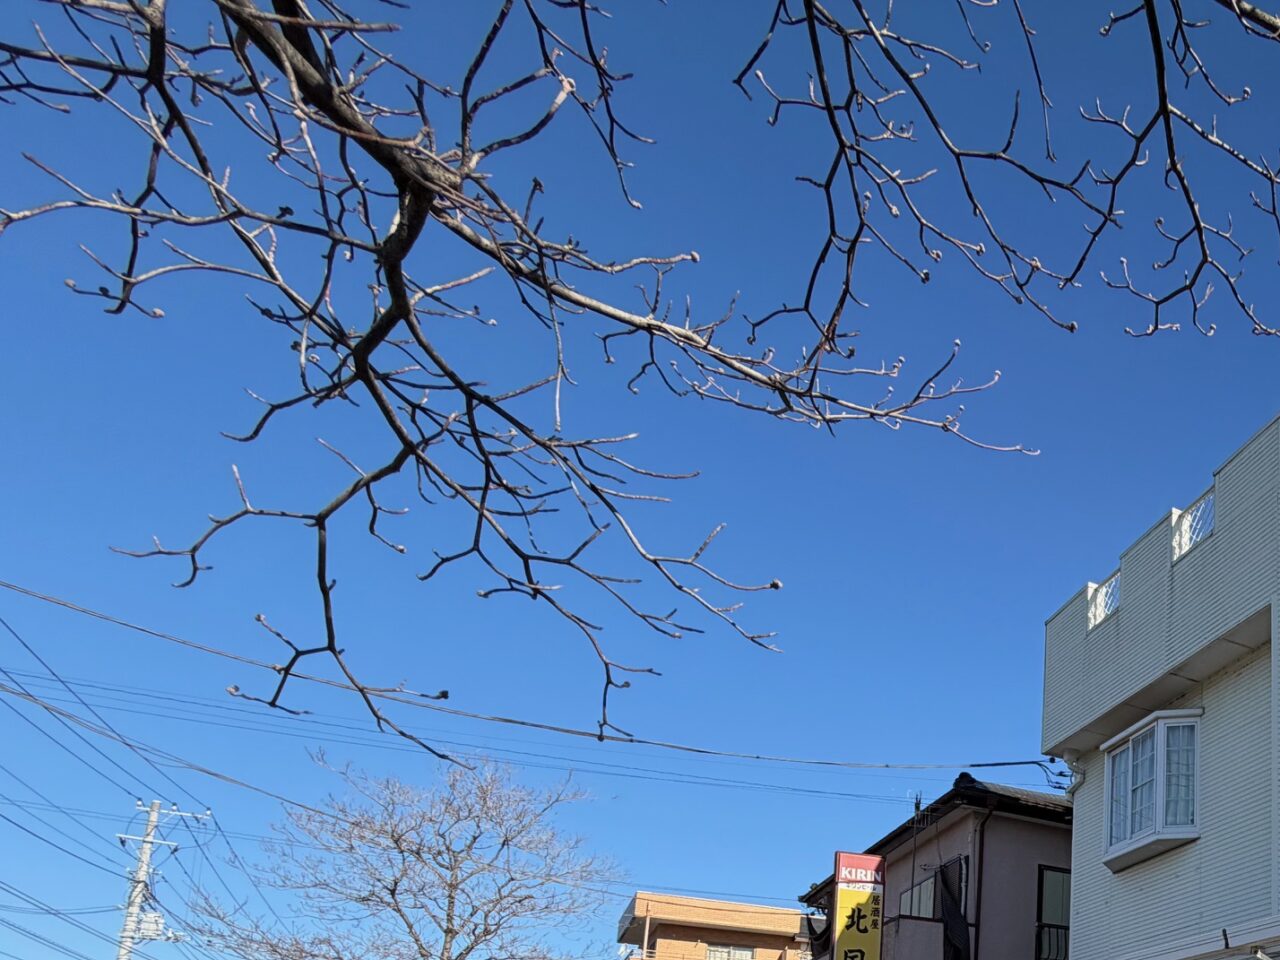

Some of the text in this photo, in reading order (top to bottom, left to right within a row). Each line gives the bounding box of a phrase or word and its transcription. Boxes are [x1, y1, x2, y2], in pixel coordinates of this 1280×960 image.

[840, 866, 882, 882] KIRIN
[870, 894, 881, 930] 居酒屋
